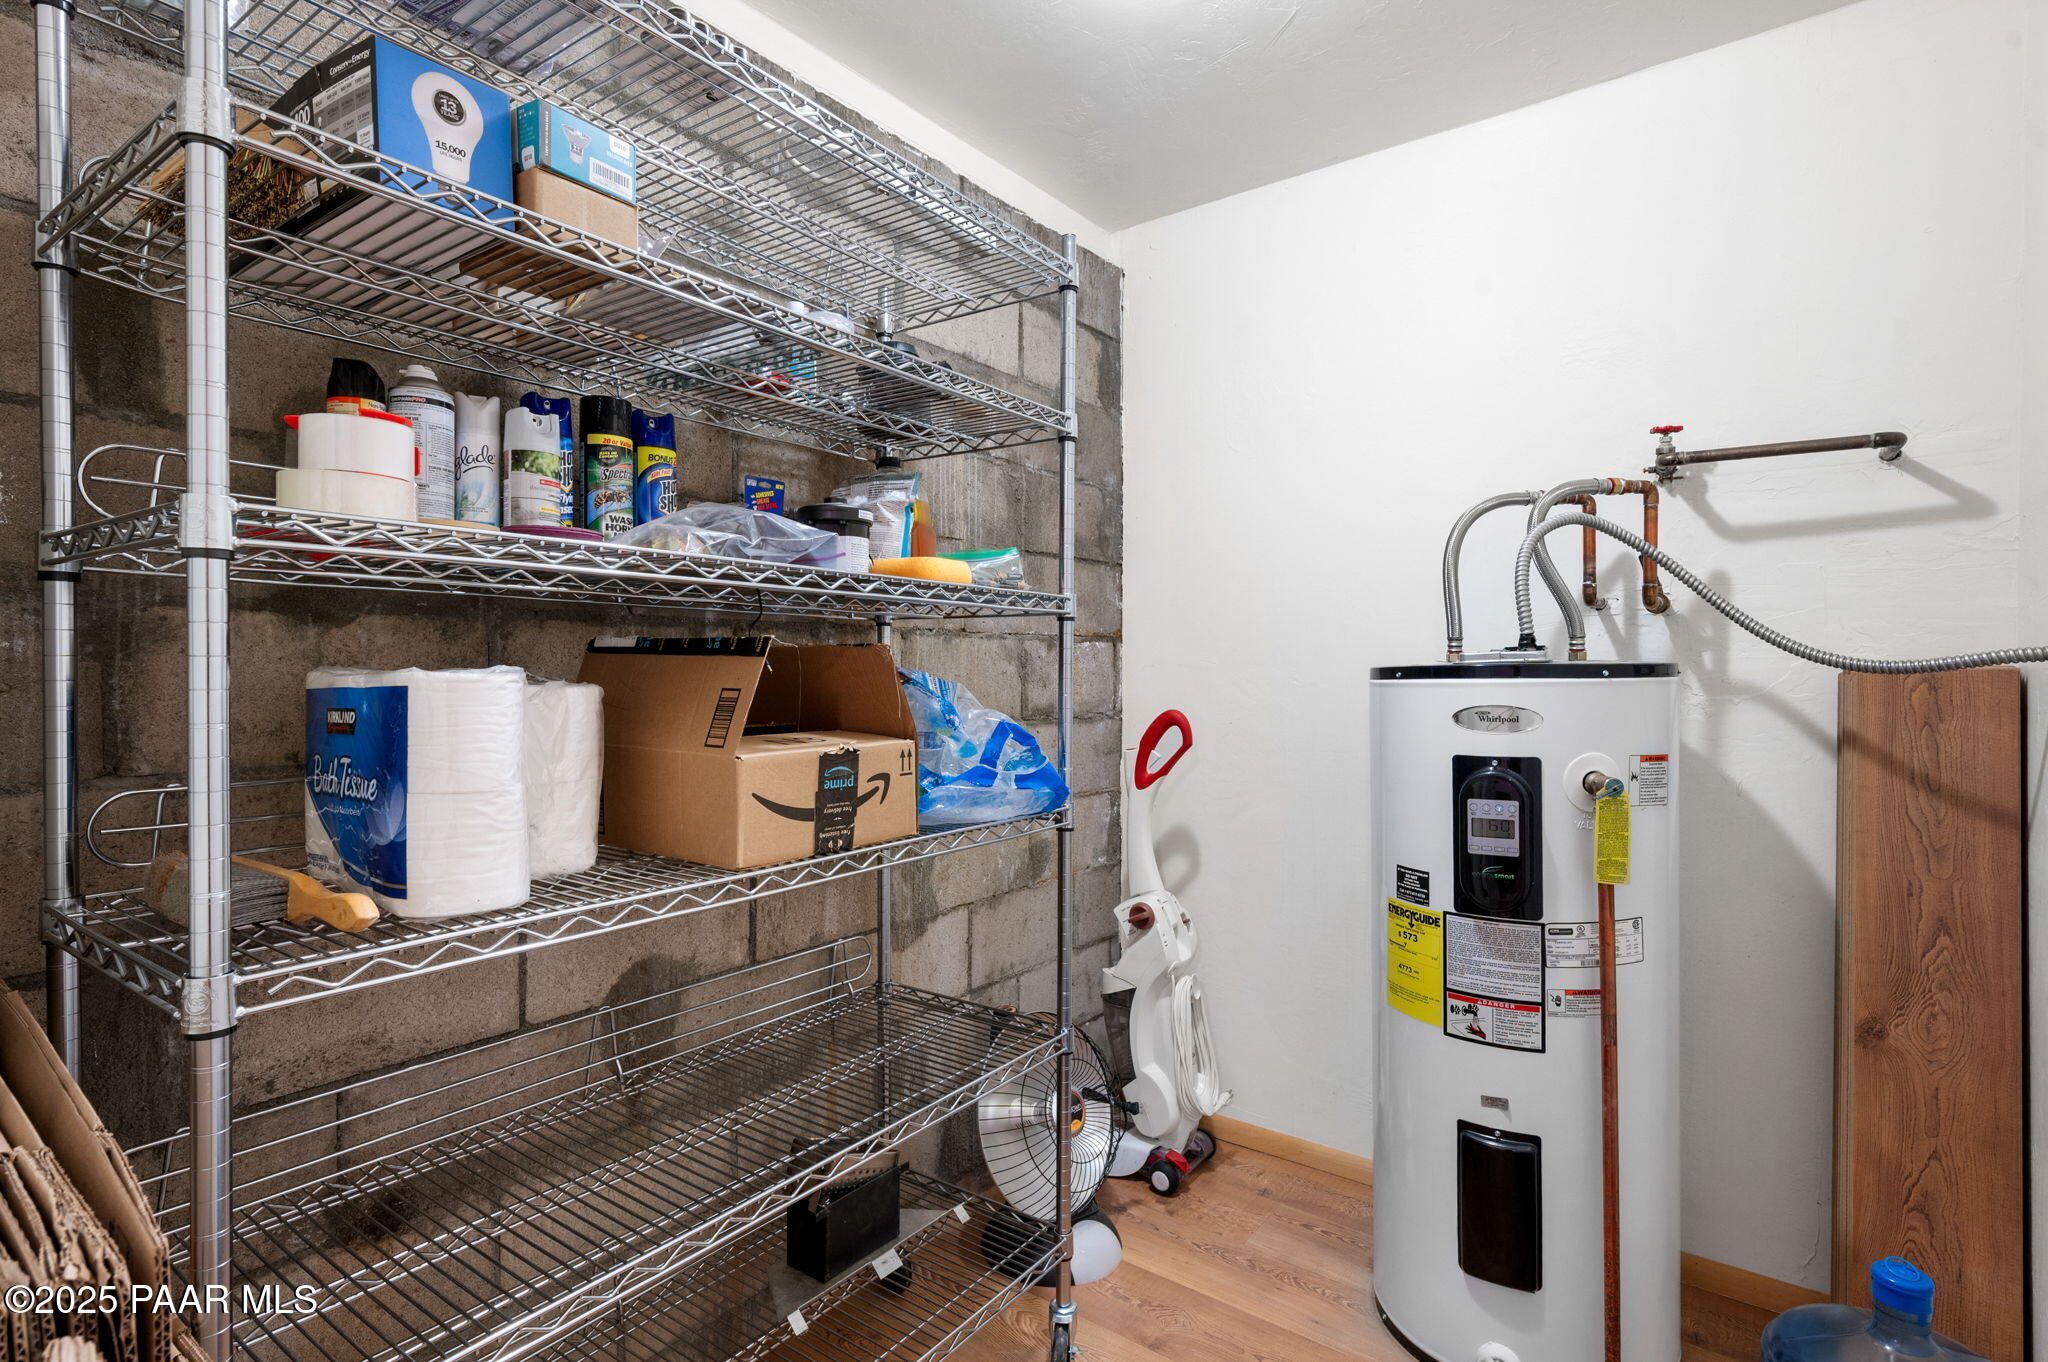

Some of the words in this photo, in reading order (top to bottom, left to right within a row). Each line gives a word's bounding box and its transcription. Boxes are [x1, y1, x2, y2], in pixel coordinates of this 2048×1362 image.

[440, 97, 457, 115] 13
[435, 140, 466, 158] 15,000
[454, 445, 494, 479] glade
[648, 454, 673, 464] BONUS
[600, 468, 632, 481] Spectr
[659, 480, 678, 495] HO
[609, 515, 633, 525] WAS
[605, 523, 633, 532] HORN
[327, 711, 356, 724] KIRKLAND
[1478, 715, 1519, 724] Whirlpool
[312, 755, 341, 793] Bath
[340, 757, 378, 801] Tissue
[823, 775, 854, 790] prime
[824, 806, 843, 815] delivery
[1482, 1000, 1516, 1009] DANGER
